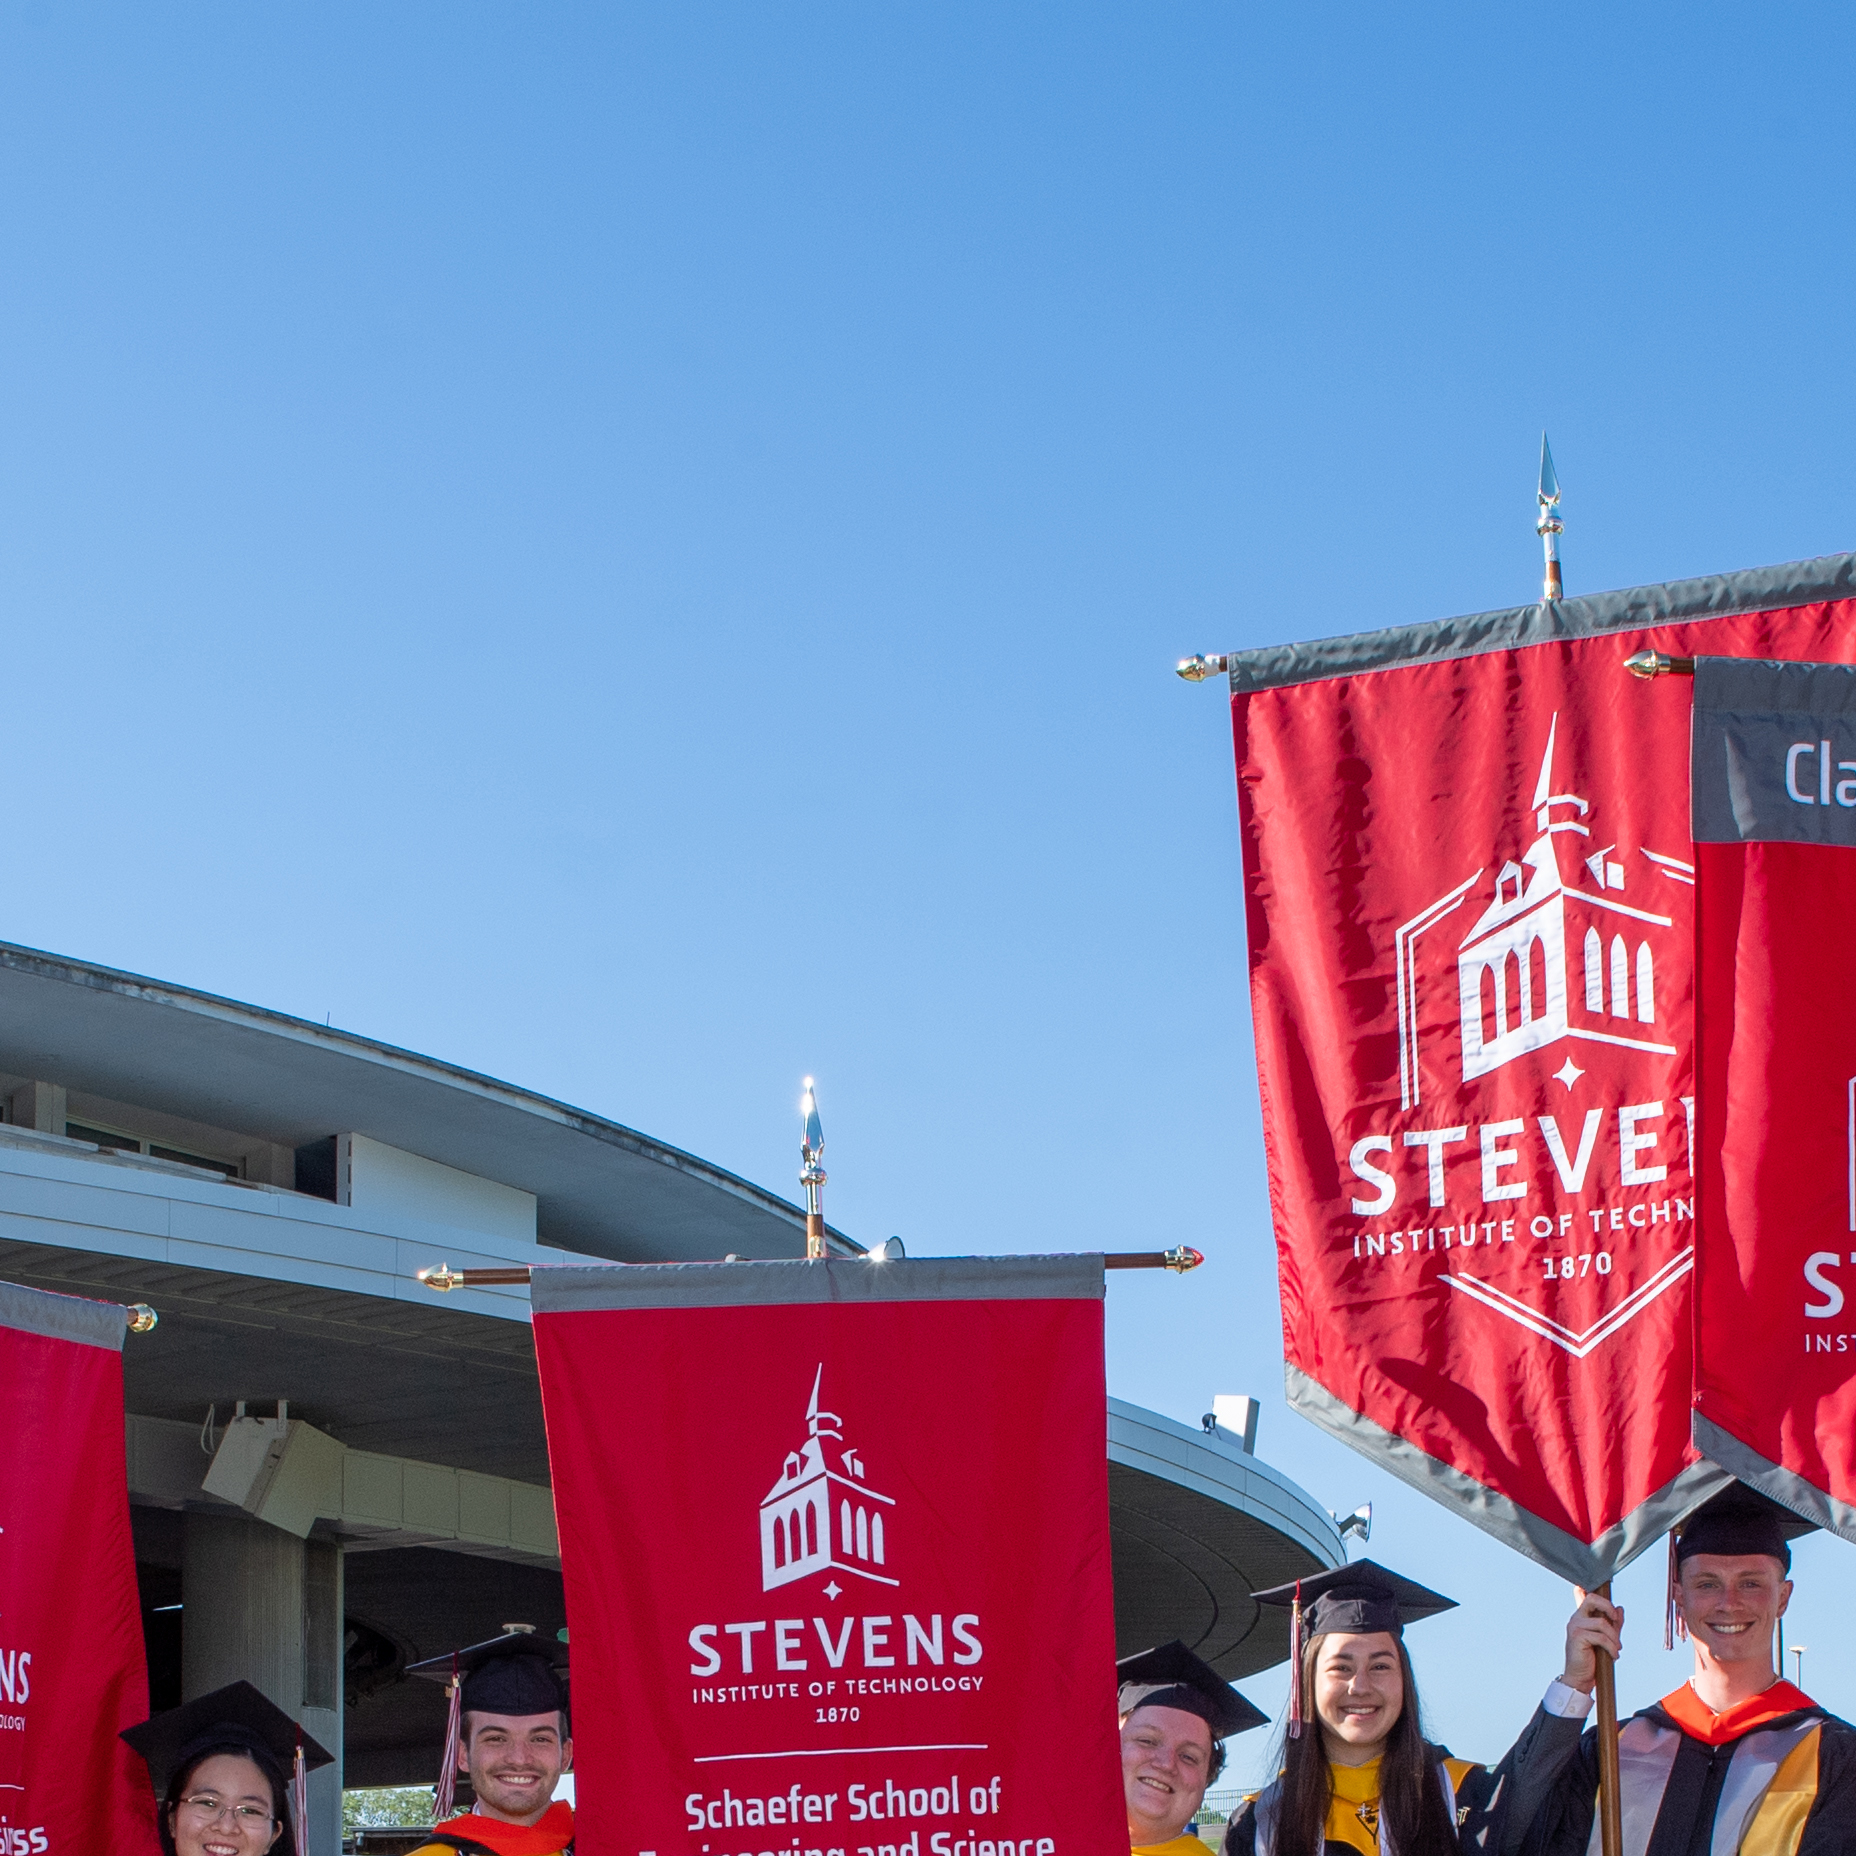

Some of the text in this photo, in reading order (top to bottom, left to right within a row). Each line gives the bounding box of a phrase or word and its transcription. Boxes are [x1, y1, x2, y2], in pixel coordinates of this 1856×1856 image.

[1348, 1096, 1694, 1216] STEVE
[1354, 1196, 1694, 1258] INSTITUTE OF TECHN
[1543, 1251, 1612, 1280] 1870
[688, 1613, 984, 1677] STEVENS
[693, 1676, 984, 1704] INSTITUTE OF TECHNOLOGY
[816, 1706, 860, 1724] 1870
[685, 1775, 1002, 1831] Schaefer School of
